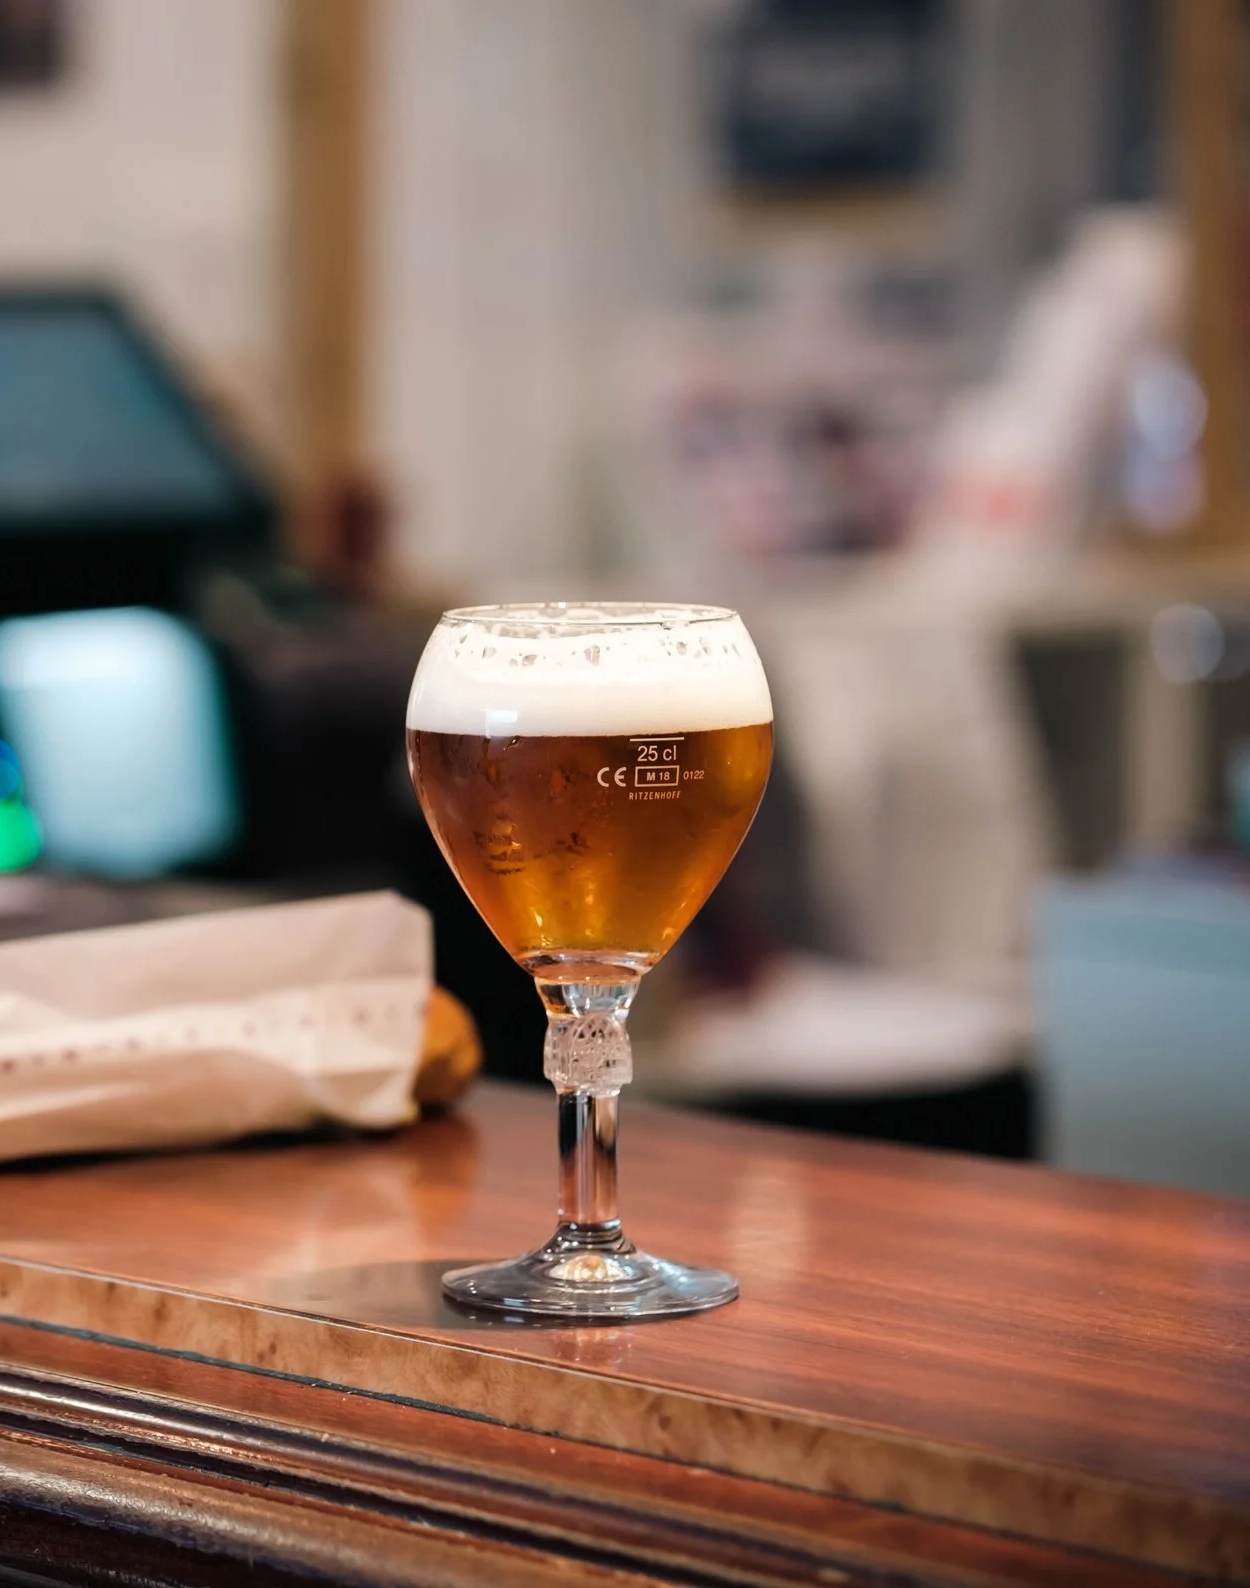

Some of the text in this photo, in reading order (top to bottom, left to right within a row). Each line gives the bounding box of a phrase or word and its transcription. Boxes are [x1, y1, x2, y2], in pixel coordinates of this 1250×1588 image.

[637, 745, 677, 762] 25 cl
[646, 771, 656, 781] M
[658, 771, 670, 781] 18
[683, 770, 704, 780] 0122
[628, 791, 681, 800] RITZENHOFF
